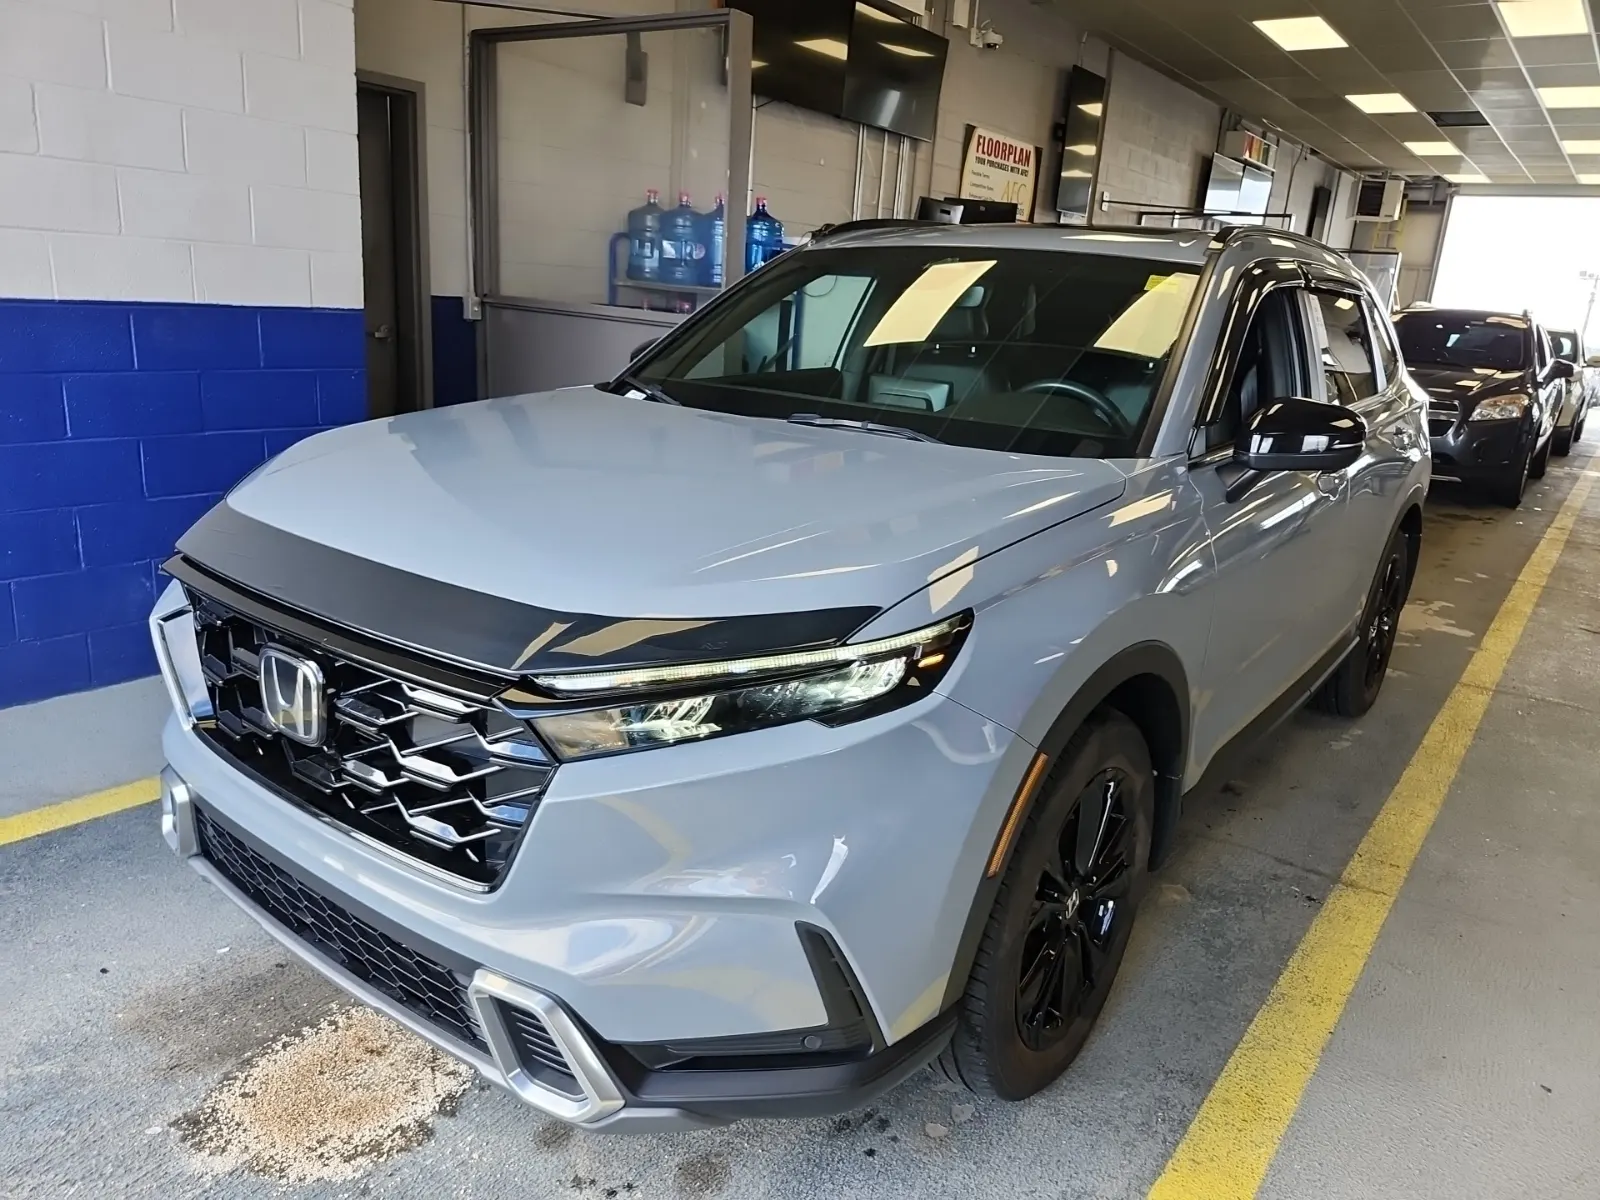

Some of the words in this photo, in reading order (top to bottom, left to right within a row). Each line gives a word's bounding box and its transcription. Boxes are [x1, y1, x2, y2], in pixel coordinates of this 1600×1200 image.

[976, 134, 1031, 167] FLOORPLAN
[975, 156, 986, 166] YOUR
[986, 159, 1009, 172] PURCHASES
[1010, 166, 1020, 175] WITH
[1000, 180, 1027, 205] AFC
